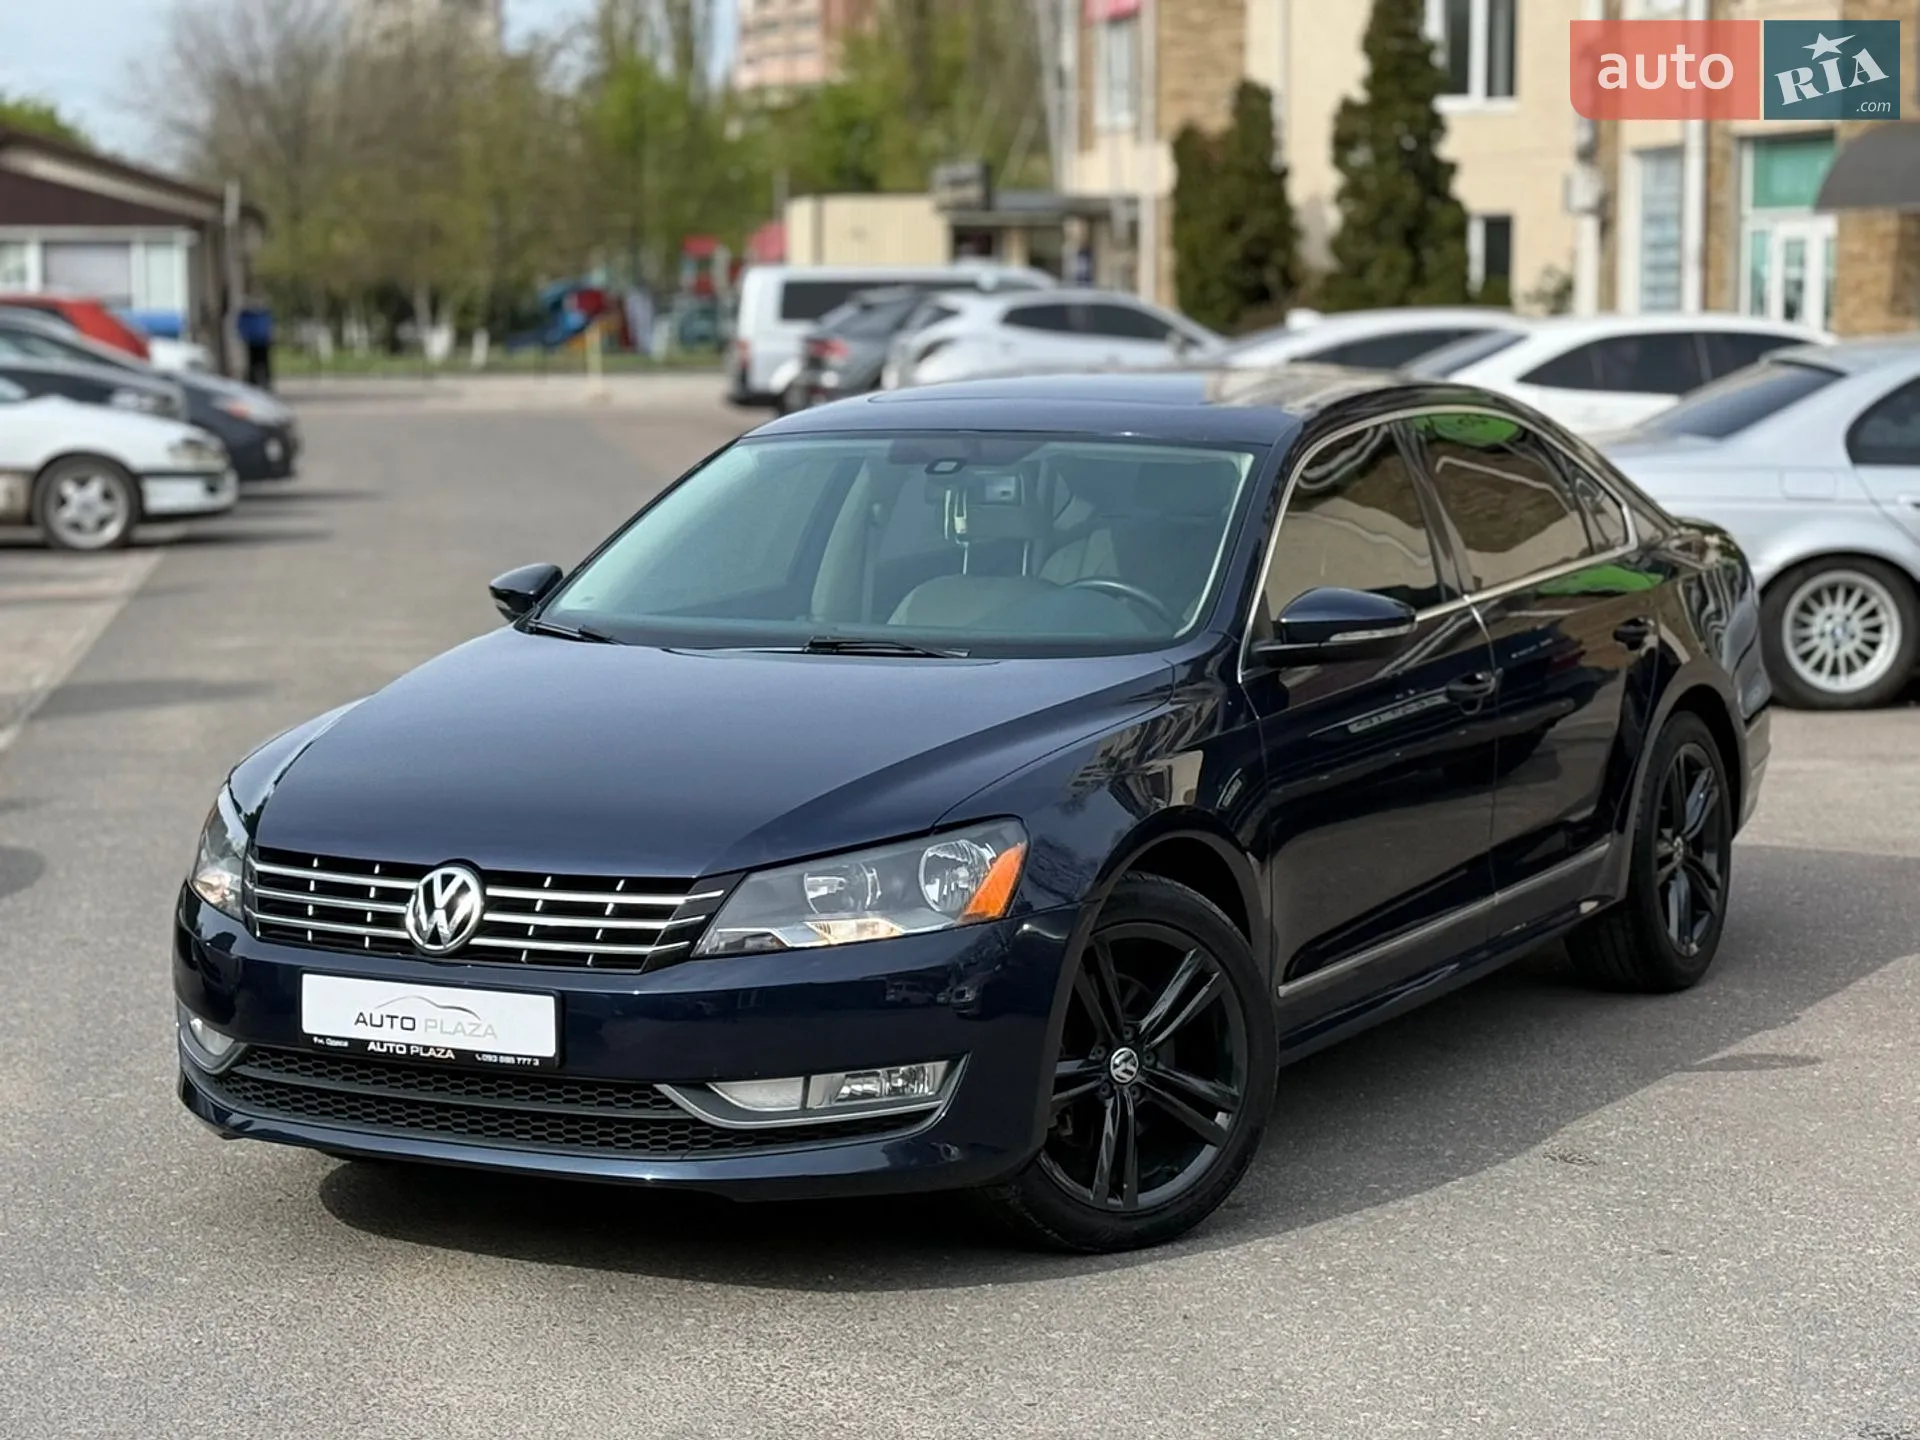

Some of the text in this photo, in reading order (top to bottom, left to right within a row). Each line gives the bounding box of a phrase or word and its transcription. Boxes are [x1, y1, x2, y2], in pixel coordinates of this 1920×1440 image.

[354, 1011, 498, 1040] AUTO PLAZA
[367, 1041, 455, 1060] AUTO PLAZA
